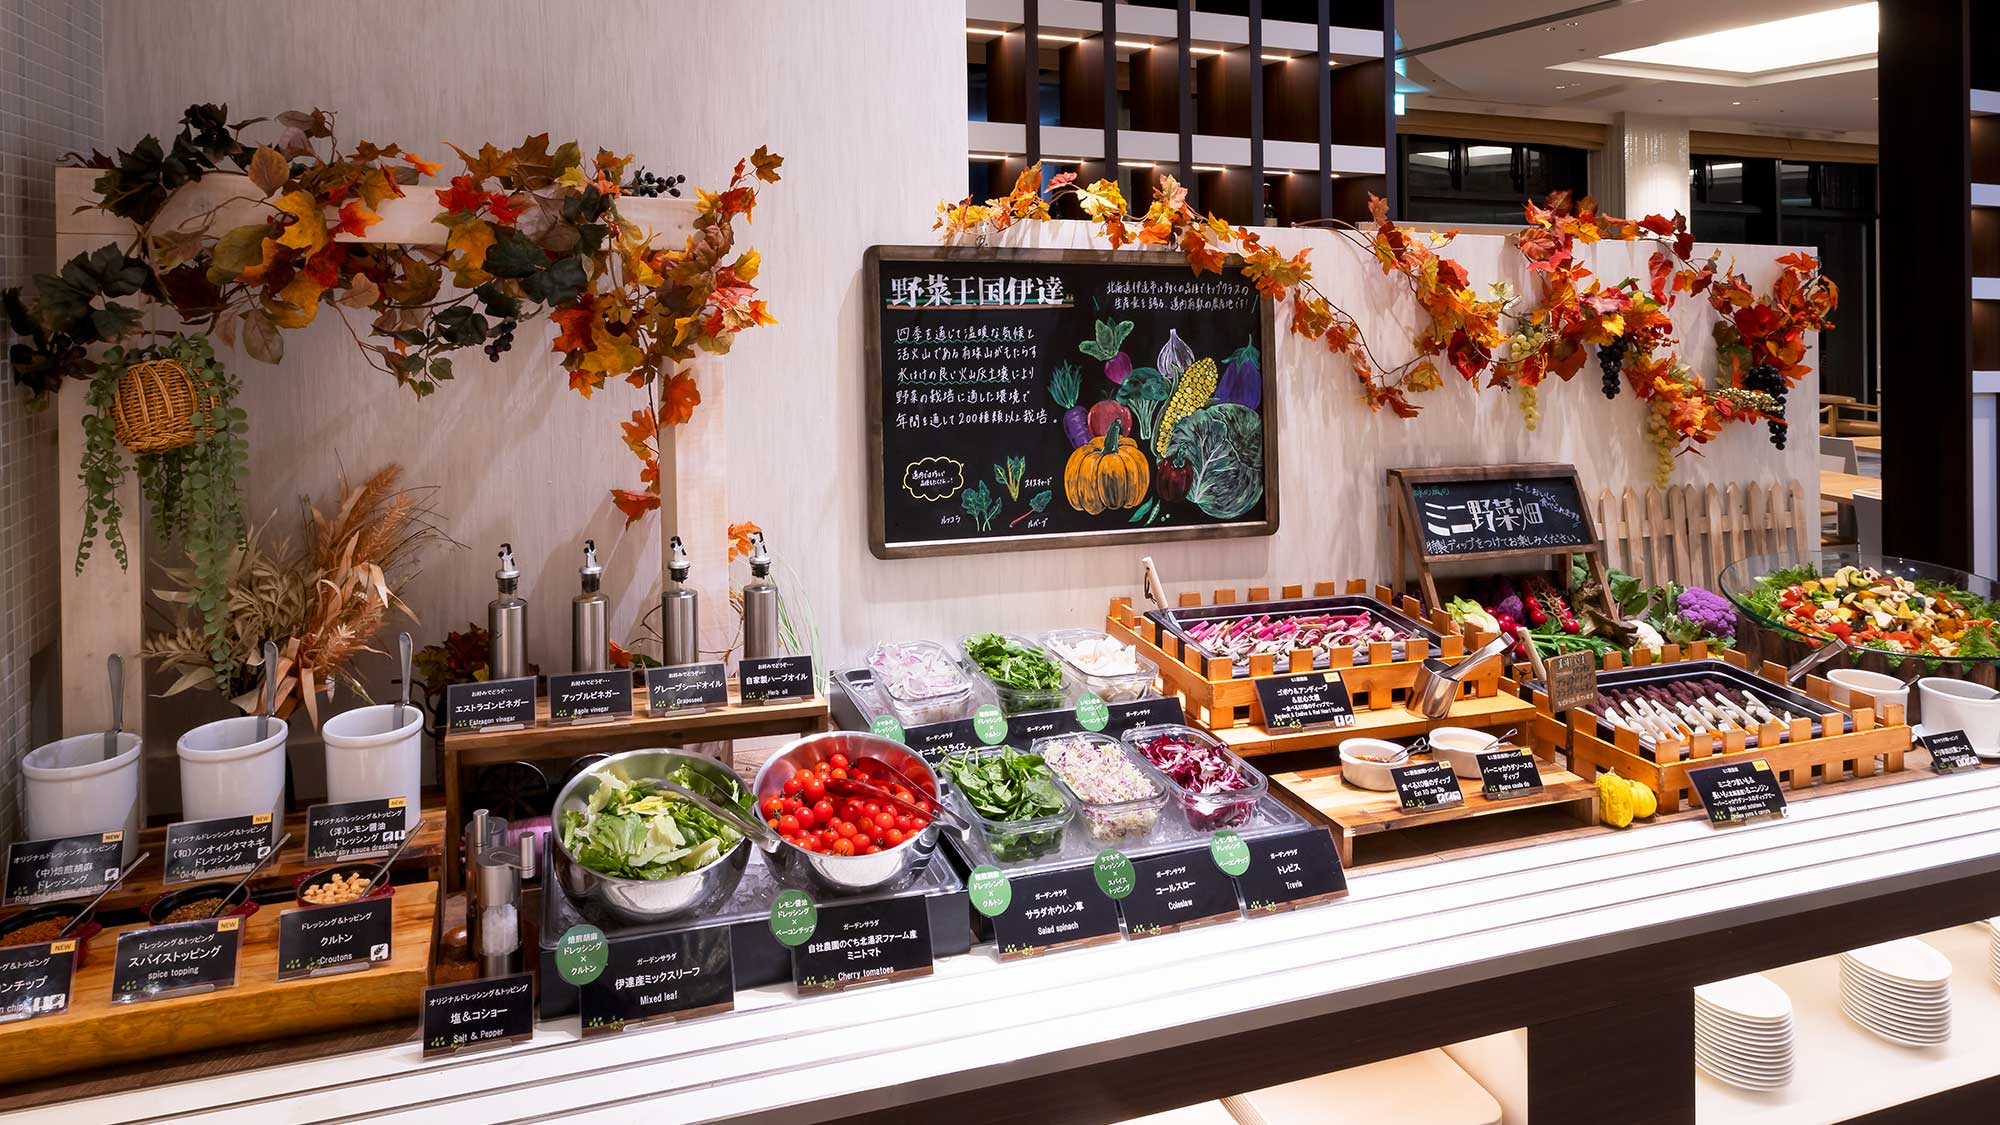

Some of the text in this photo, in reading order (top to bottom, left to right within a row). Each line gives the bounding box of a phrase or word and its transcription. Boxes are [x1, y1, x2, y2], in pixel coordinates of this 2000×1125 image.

[891, 273, 1064, 307] 野菜王国伊達
[897, 325, 1035, 341] 四季を通じて温暖な気候と
[897, 345, 1037, 361] 活火山である有珠山がもたらす
[897, 365, 1035, 382] 水はけの良い火山灰土壌により
[896, 388, 1031, 404] 野菜の栽培に適した環境で
[1425, 497, 1544, 537] ミニ野菜畑
[746, 672, 808, 685] 自家製ハーブオイル
[653, 680, 723, 694] グレープシードオイル
[562, 689, 620, 702] アップルビネガー
[455, 698, 529, 713] エストラゴンビネガー
[574, 705, 609, 716] Apple vinegar
[335, 833, 379, 847] ドレッシング
[173, 838, 265, 858] (和)ノンオイルタマネギ
[195, 852, 242, 867] ドレッシング
[1099, 860, 1126, 872] ドレッシング
[1277, 863, 1301, 875] トレビス
[37, 874, 89, 889] ドレッシング
[973, 879, 1004, 891] ドレッシング
[1107, 877, 1128, 886] スパイス
[1155, 881, 1196, 895] コールスロー
[1035, 889, 1068, 900] ガーデンサラダ
[1108, 884, 1130, 895] トッピング
[982, 898, 1003, 907] クルトン
[777, 908, 810, 919] ドレッシング
[1025, 901, 1085, 920] サラダホウレン草
[776, 925, 815, 936] ベーコンチップ
[843, 919, 880, 931] ガーデンサラダ
[1037, 921, 1079, 936] Salad spinach
[55, 943, 71, 951] NEW
[320, 934, 353, 947] クルトン
[808, 930, 917, 953] 自社農園のぐち北湯沢ファーム産
[563, 942, 602, 955] ドレッシング
[847, 947, 882, 960] ミニトマト
[128, 945, 222, 968] スパイストッピング
[320, 953, 353, 965] Croutons
[637, 953, 678, 966] ガーデンサラダ
[148, 966, 199, 980] spice topping
[571, 965, 597, 976] クルトン
[838, 966, 894, 981] Cherry tomatoes
[615, 967, 700, 990] 伊達産ミックスリーフ
[640, 990, 678, 1006] Mixed leaf
[450, 1008, 508, 1025] 塩&コショー
[453, 1028, 504, 1043] Salt & Pepper
